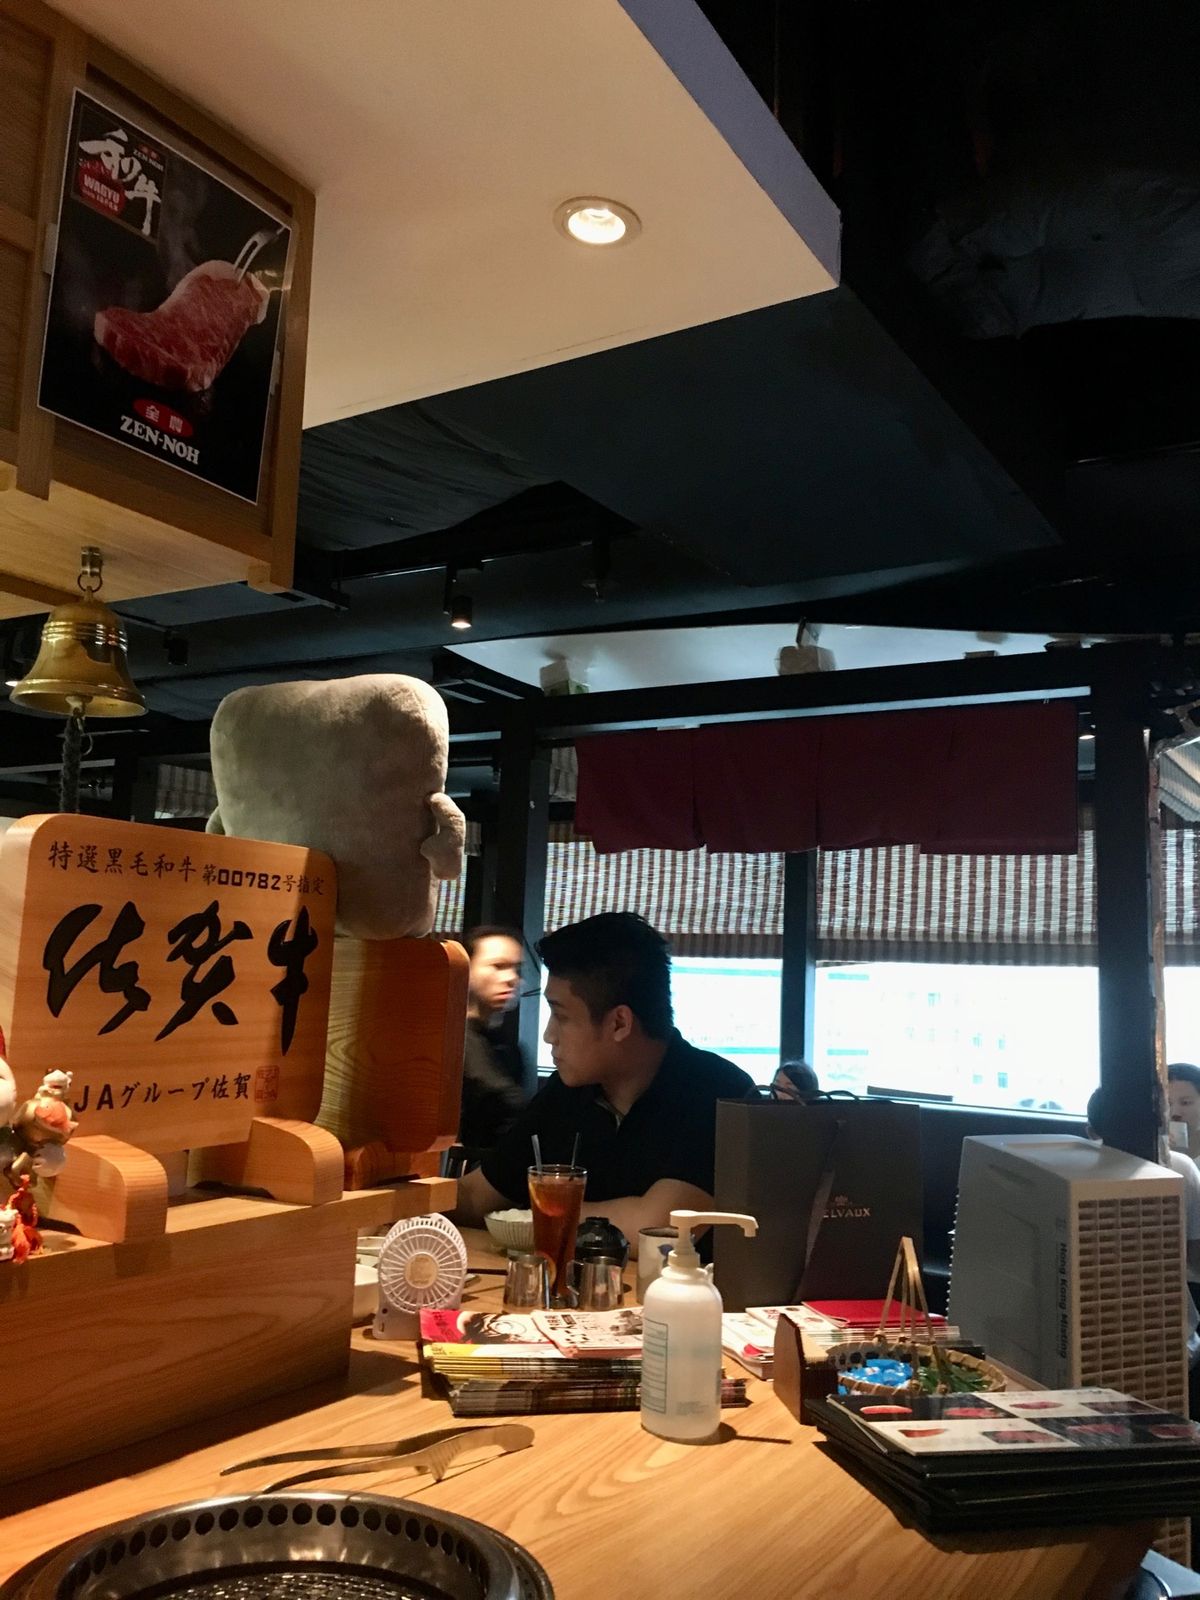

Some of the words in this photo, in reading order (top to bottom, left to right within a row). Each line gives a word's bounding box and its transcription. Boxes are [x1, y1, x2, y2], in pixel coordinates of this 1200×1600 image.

[120, 414, 201, 465] ZEN-NOH
[48, 841, 197, 882] 特選黒毛和牛
[42, 900, 320, 1057] 佐賀牛
[823, 1207, 872, 1218] ELVAUX
[1059, 1242, 1068, 1275] Hong
[1059, 1276, 1068, 1310] Kong
[1059, 1313, 1069, 1359] Misting
